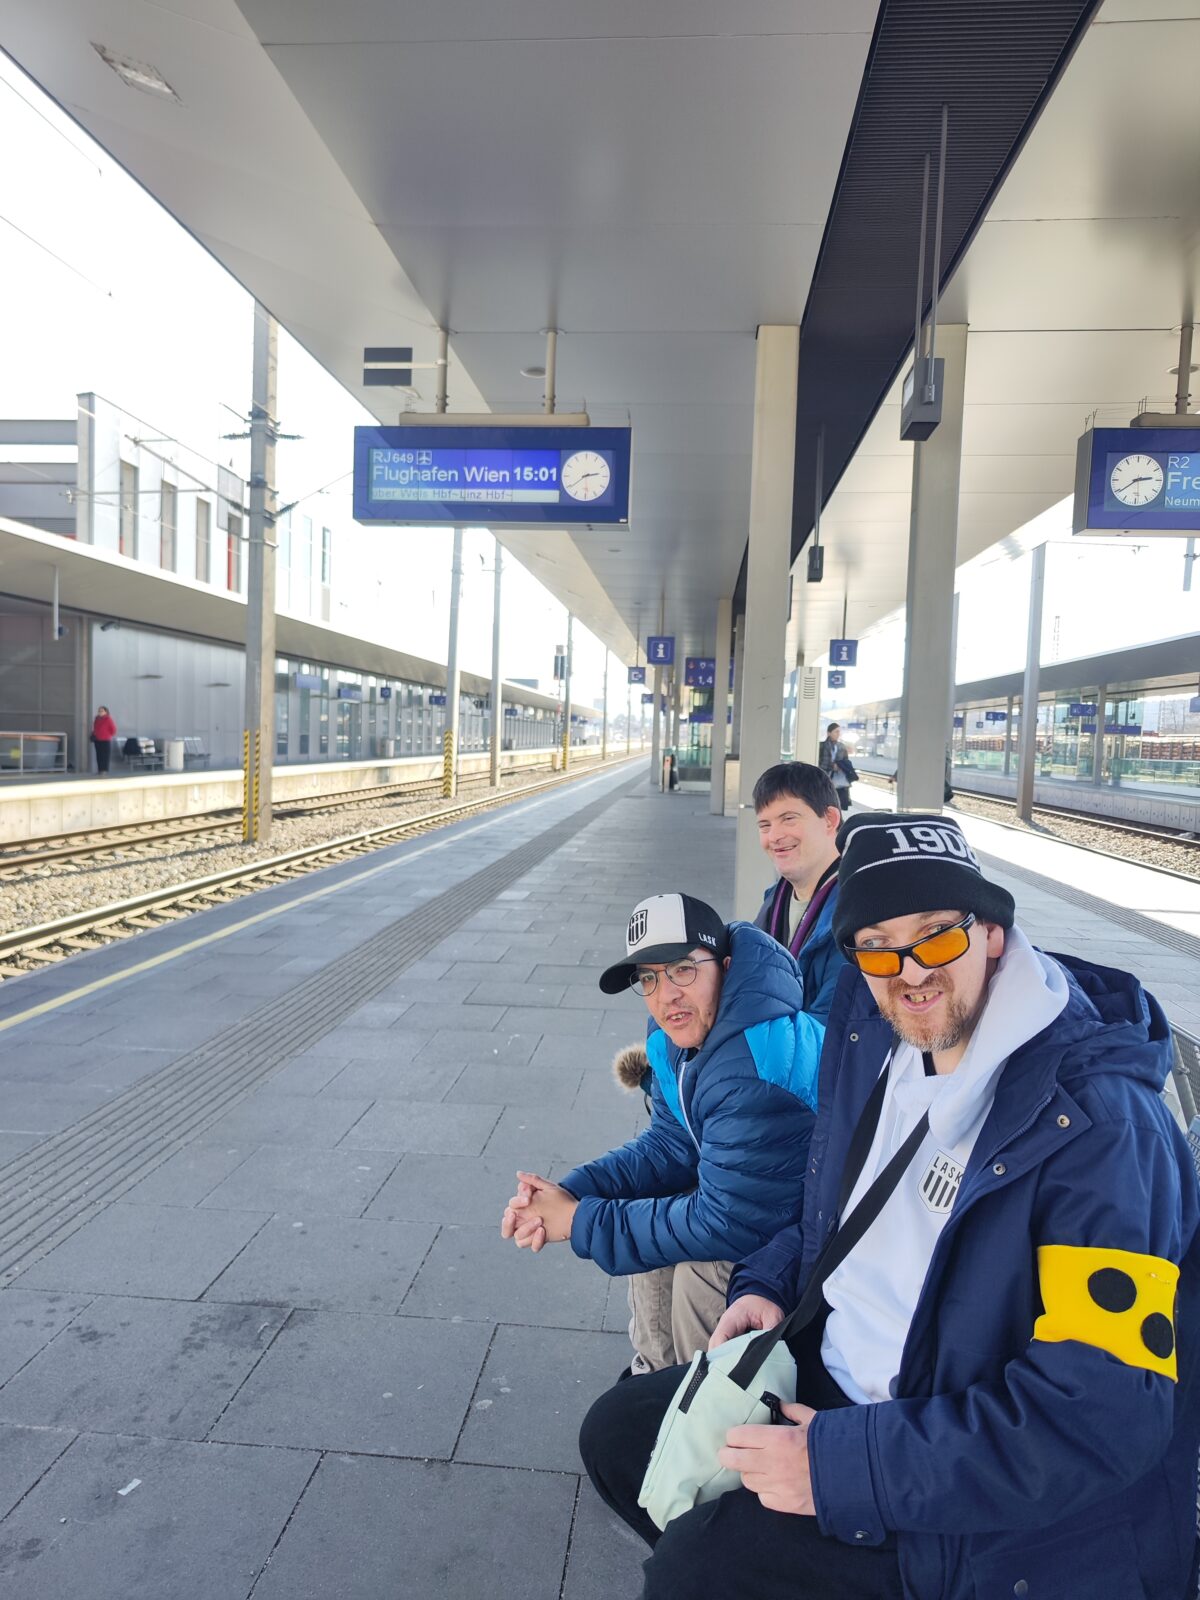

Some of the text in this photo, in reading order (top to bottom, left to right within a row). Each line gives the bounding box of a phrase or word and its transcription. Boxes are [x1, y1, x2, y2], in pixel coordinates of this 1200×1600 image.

[1168, 456, 1190, 469] R2
[372, 465, 557, 485] Flughafen Wien 15:01
[698, 932, 717, 947] LASK
[933, 1156, 964, 1184] LASK
